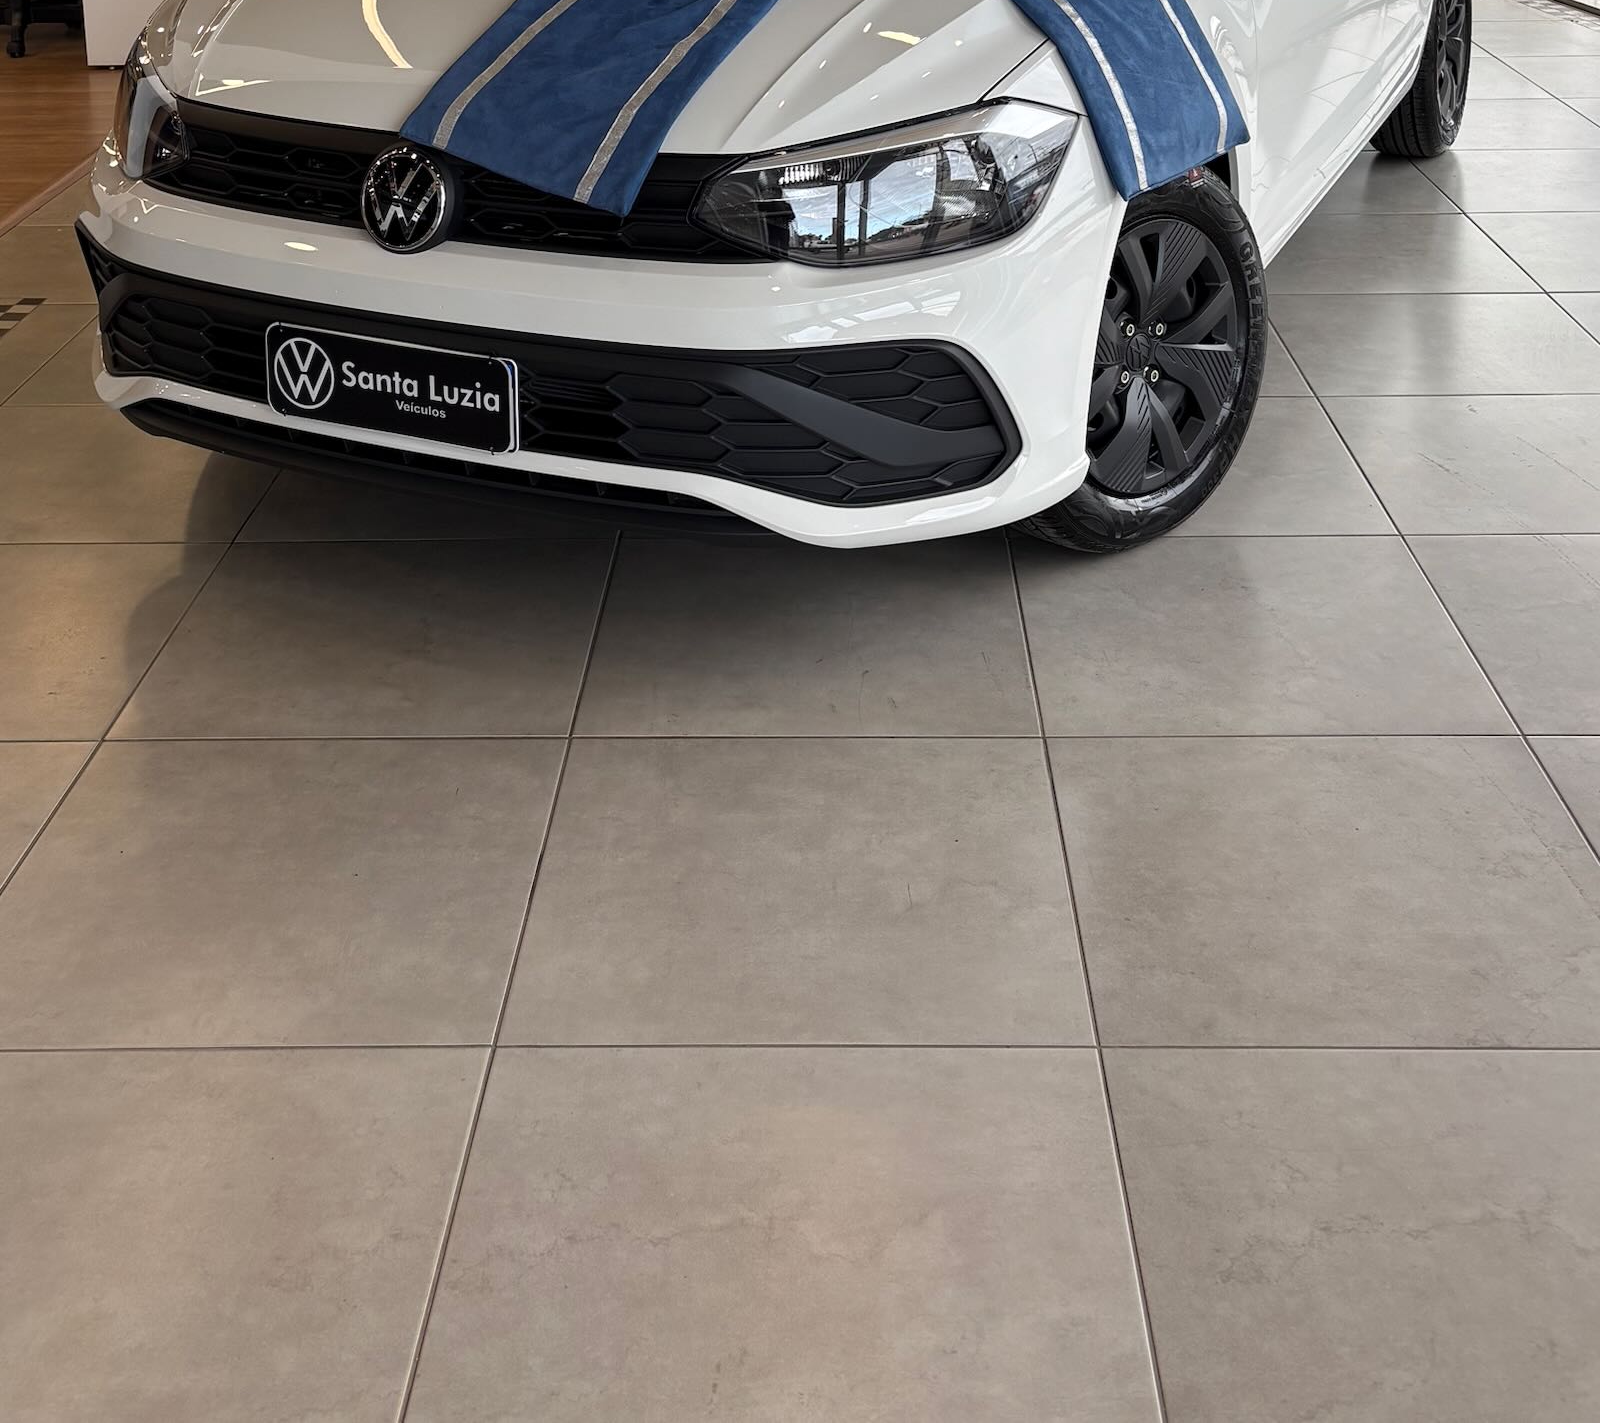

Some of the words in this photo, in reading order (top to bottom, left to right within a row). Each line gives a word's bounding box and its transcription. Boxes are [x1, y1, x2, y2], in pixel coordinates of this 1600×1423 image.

[341, 361, 419, 397] Santa
[429, 375, 500, 413] Luzia
[395, 399, 447, 419] Veículos
